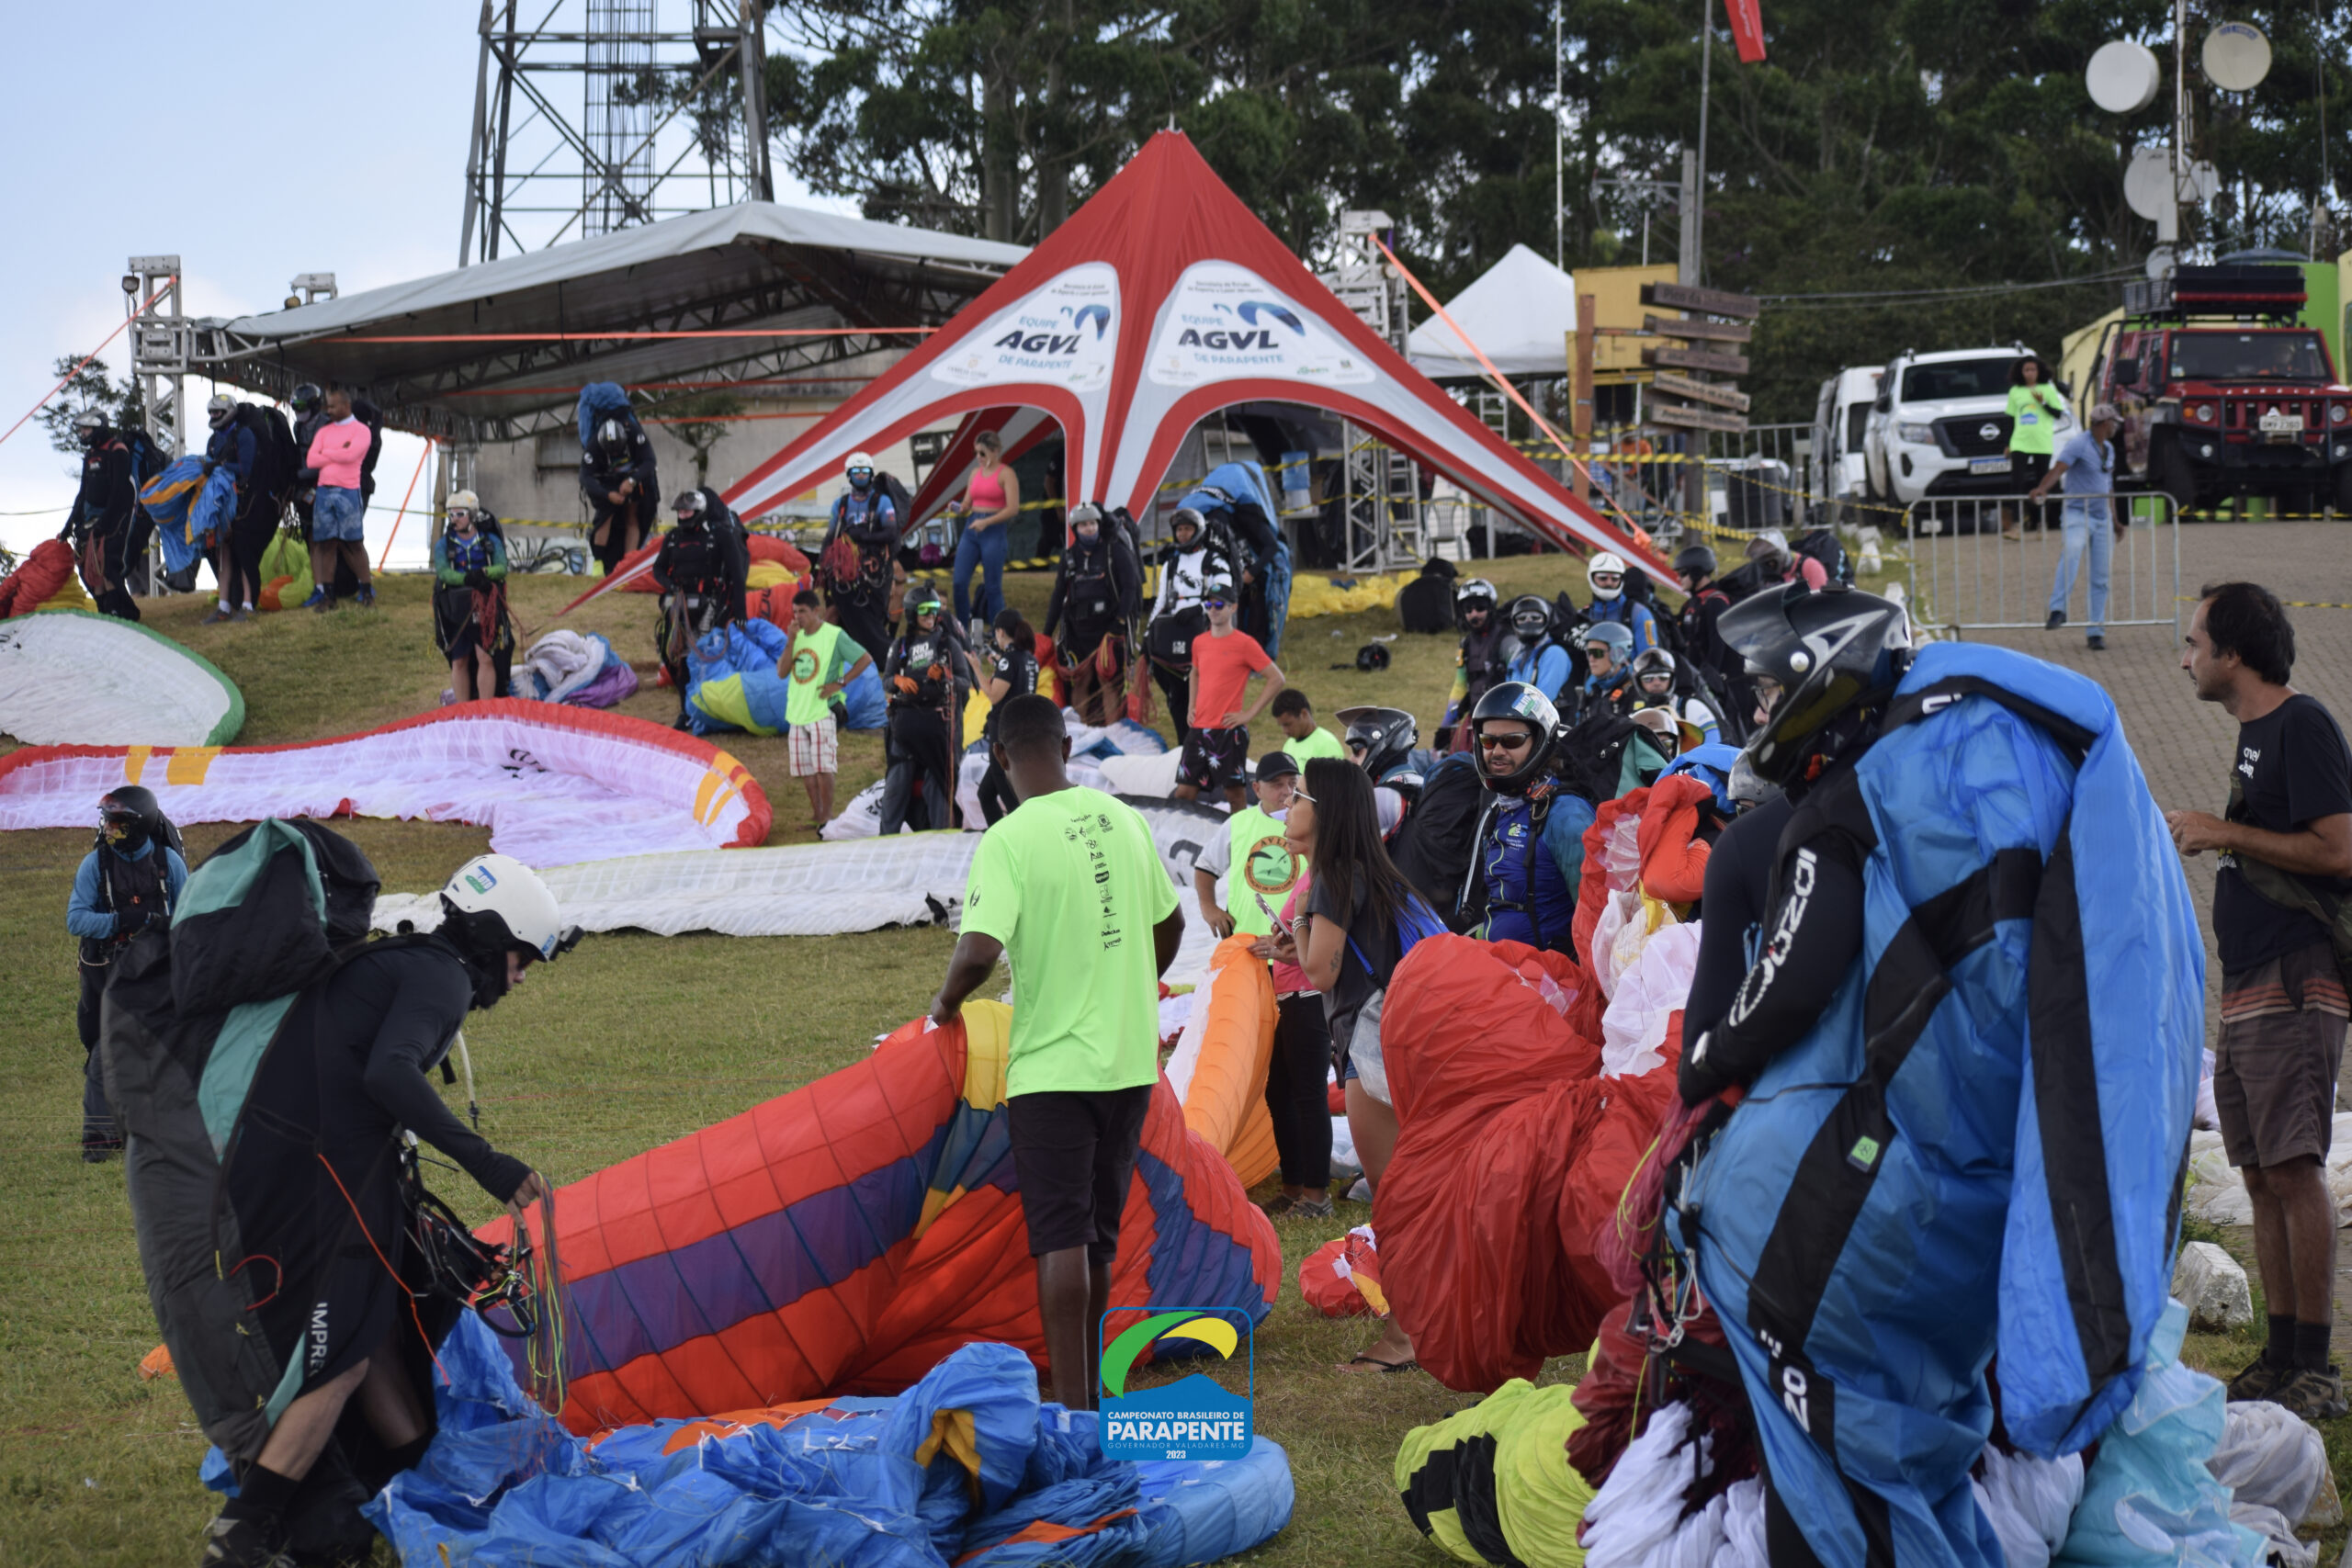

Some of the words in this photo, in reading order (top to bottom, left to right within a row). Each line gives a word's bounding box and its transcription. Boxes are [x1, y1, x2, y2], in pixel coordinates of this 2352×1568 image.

[1019, 316, 1058, 329] EQUIPE
[1182, 314, 1224, 326] EQUIPE
[993, 331, 1082, 355] AGVL
[1178, 329, 1279, 350] AGVL
[999, 355, 1013, 365] DE
[1016, 356, 1073, 370] PARAPENTE
[1194, 353, 1210, 364] DE
[1211, 354, 1284, 365] PARAPENTE
